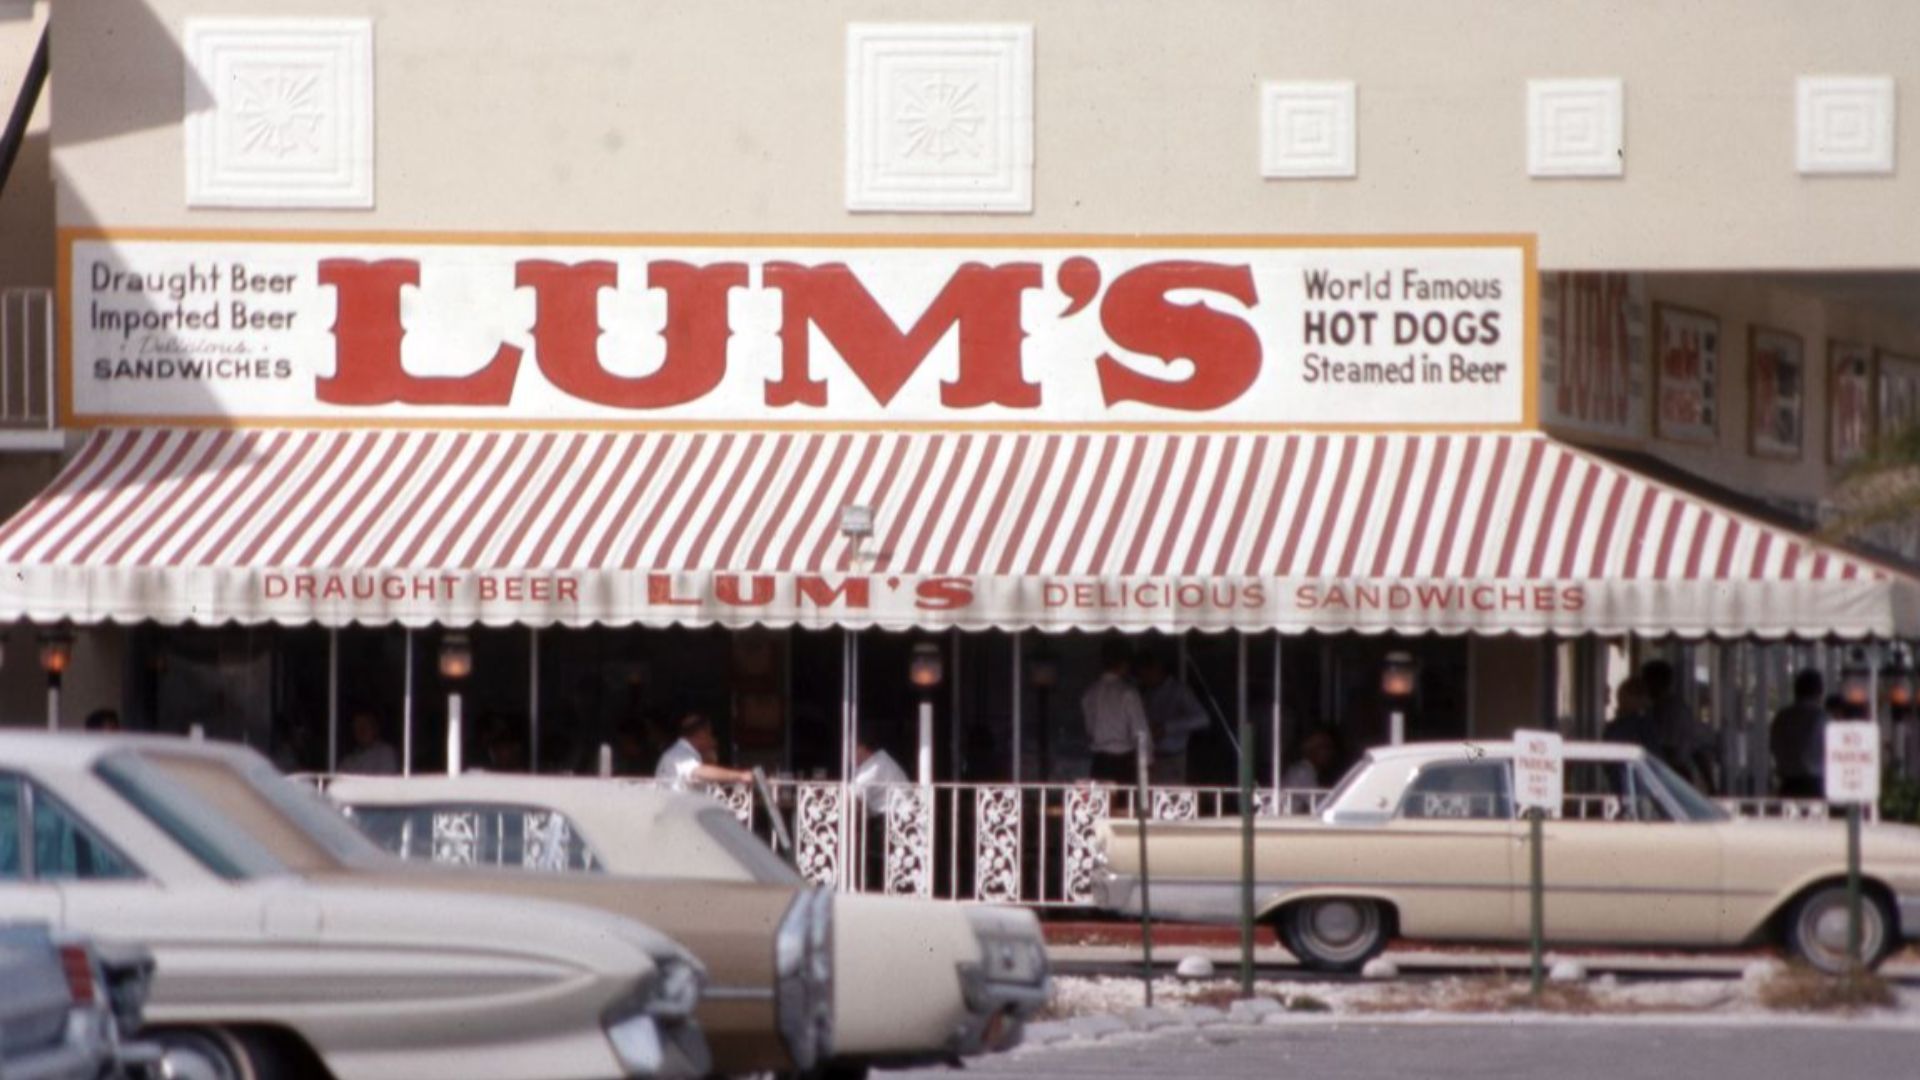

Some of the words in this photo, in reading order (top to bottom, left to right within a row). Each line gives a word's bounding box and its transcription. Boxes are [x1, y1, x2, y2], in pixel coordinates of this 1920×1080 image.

[90, 262, 222, 299] Draught
[231, 263, 298, 293] Beer
[1303, 268, 1391, 301] World
[1402, 268, 1502, 301] Famous
[90, 300, 221, 339] Imported
[231, 300, 298, 330] Beer
[315, 256, 1262, 412] LUM'S
[1303, 310, 1378, 346] HOT
[1393, 310, 1502, 346] DOGS
[93, 358, 293, 380] SANDWICHES
[1302, 352, 1415, 383] Steamed
[1421, 353, 1443, 383] in
[1449, 353, 1507, 383] Beer
[264, 574, 460, 600] DRAUGHT
[479, 576, 579, 601] BEER
[647, 574, 975, 611] LUM'S
[1042, 582, 1266, 609] DELICIOUS
[1295, 583, 1585, 611] SANDWICHES
